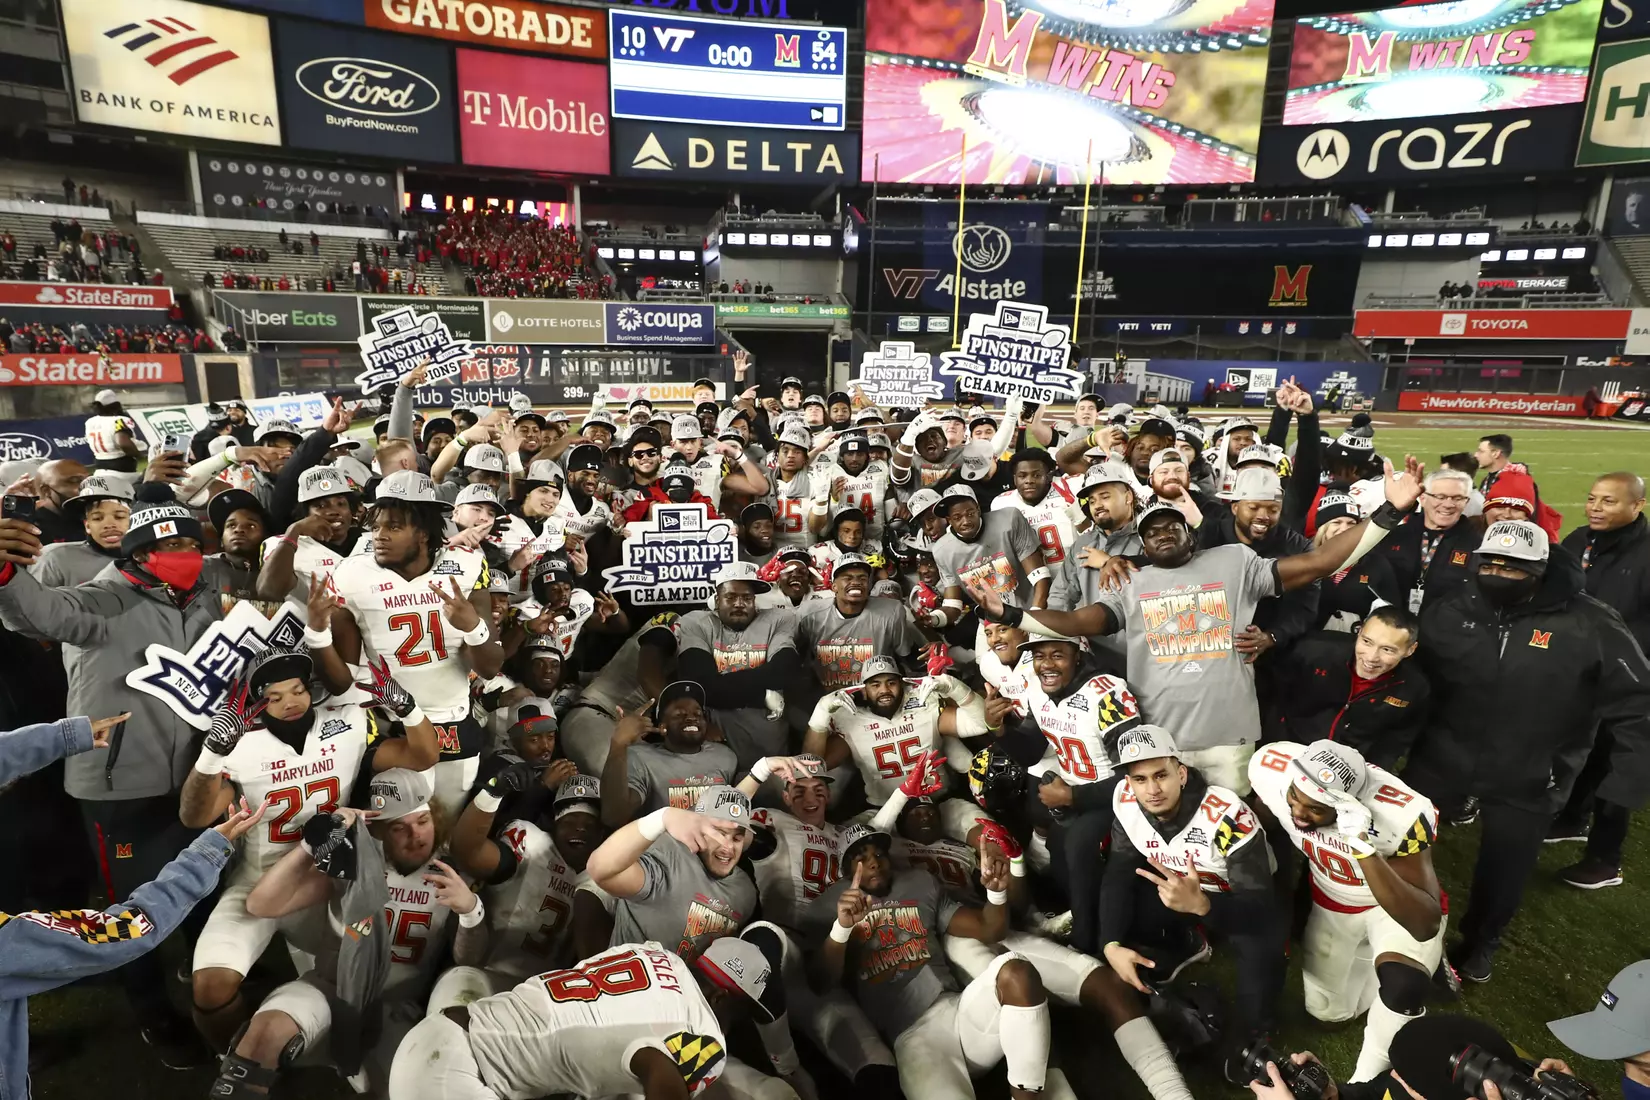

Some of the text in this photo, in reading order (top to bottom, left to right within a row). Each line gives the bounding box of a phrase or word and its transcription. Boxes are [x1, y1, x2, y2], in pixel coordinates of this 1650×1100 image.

[381, 0, 594, 49] GATORADE
[621, 25, 646, 48] 10
[708, 44, 752, 67] 0:00
[812, 41, 837, 62] 54
[1408, 29, 1537, 72] WINS
[1047, 40, 1176, 110] WINS
[323, 63, 416, 109] Ford
[81, 89, 275, 128] BANK OF AMERICA
[497, 93, 605, 136] Mobile
[326, 114, 419, 134] BuyFordNow.com
[688, 137, 844, 174] DELTA
[1368, 119, 1531, 173] razr
[883, 268, 940, 299] VT
[935, 274, 1026, 300] Alstate
[1517, 279, 1566, 289] TERRACE
[292, 310, 338, 327] Eats
[437, 304, 479, 312] Morningside
[719, 305, 749, 313] bet365
[770, 306, 799, 314] bet365
[819, 306, 848, 315] bet365
[517, 318, 602, 329] LOTTE HOTELS
[644, 312, 702, 333] coupa
[1471, 318, 1529, 330] TOYOTA
[370, 331, 448, 368] PINSTRIPE
[644, 335, 662, 343] Spend
[970, 337, 1064, 367] PINSTRIPE
[865, 367, 928, 380] PINSTRIPE
[963, 361, 980, 371] NEW
[988, 358, 1034, 378] BOWL
[880, 381, 911, 391] BOWL
[964, 376, 1052, 402] CHAMPIONS
[153, 419, 194, 436] HESS
[306, 471, 343, 491] CHAMPIONS
[159, 523, 172, 534] M
[1487, 523, 1534, 548] CHAMPIONS
[632, 544, 731, 565] PINSTRIPE
[1038, 524, 1065, 564] 9
[658, 565, 707, 581] BOWL
[384, 592, 441, 609] MARYLAND
[635, 587, 717, 603] CHAMPION
[1140, 590, 1231, 631] PINSTRIPE BOWL
[1178, 613, 1197, 632] M
[388, 610, 449, 668] 21
[561, 635, 573, 655] 7
[1146, 625, 1233, 656] CHAMPIONS
[1529, 629, 1553, 649] M
[176, 677, 199, 700] NEW
[1005, 685, 1026, 695] MARYLA
[874, 723, 915, 742] MARYLAND
[1040, 716, 1077, 735] MARYLAND
[435, 726, 460, 751] M
[872, 736, 923, 780] 55
[271, 758, 335, 785] MARYLAND
[1310, 750, 1358, 794] CHAMPIONS
[265, 776, 341, 844] 23
[116, 843, 133, 858] M
[807, 833, 838, 849] MARYLA
[895, 906, 928, 936] BOWL
[878, 928, 897, 948] M
